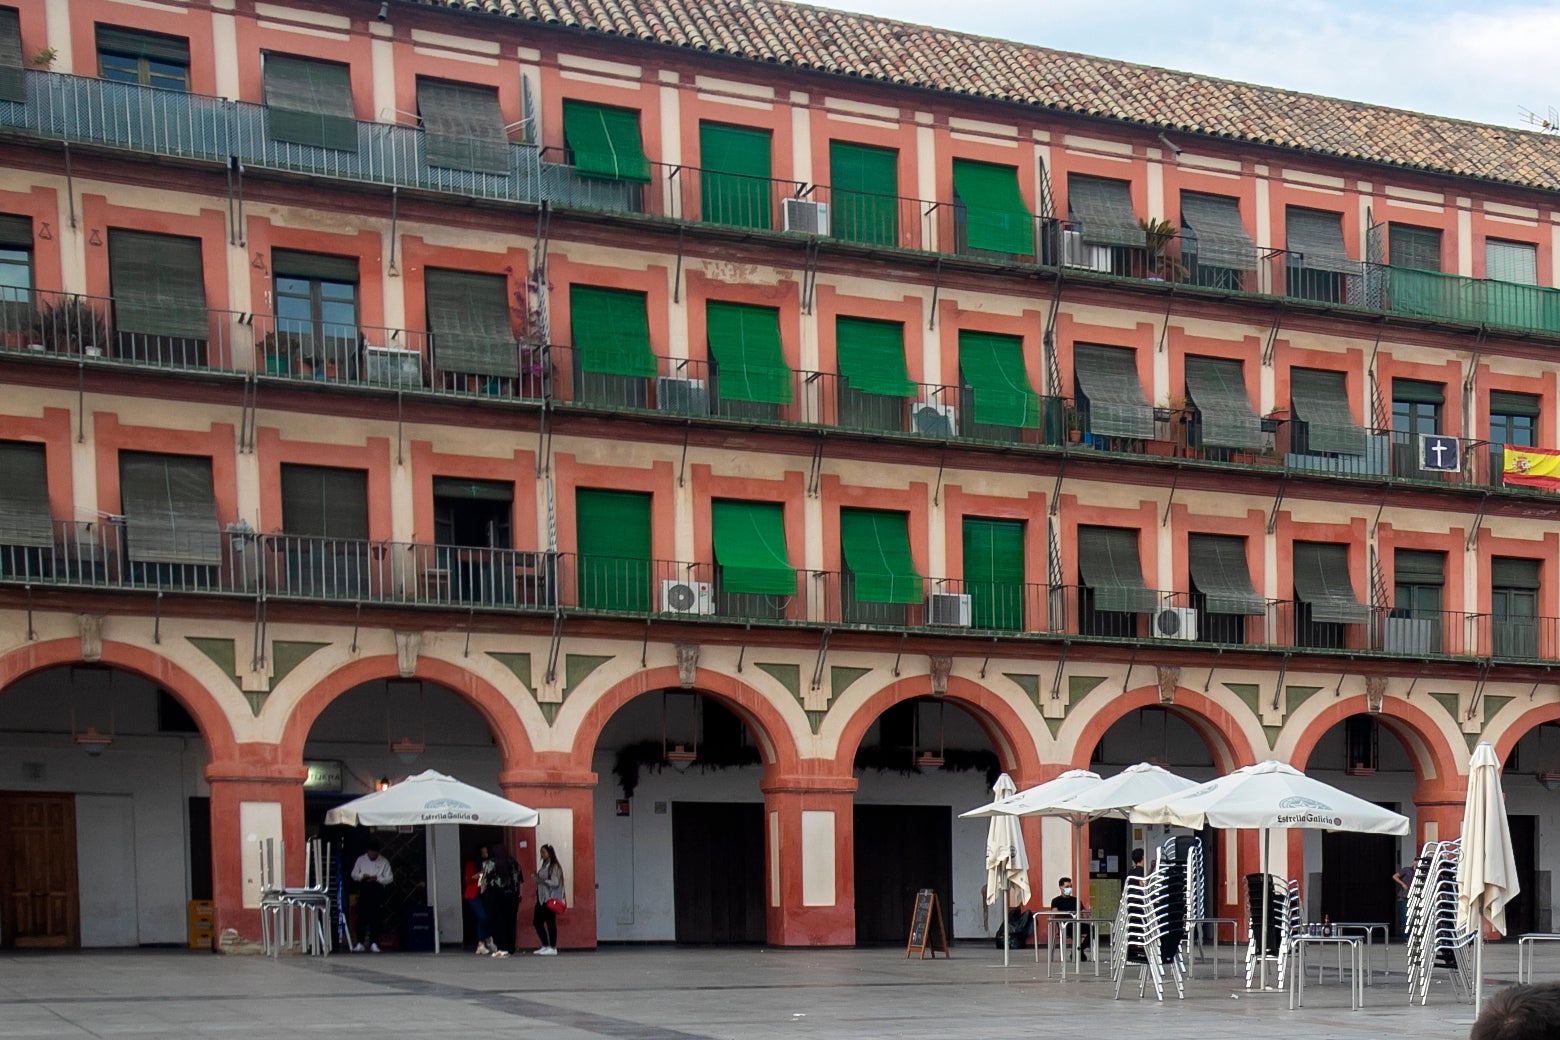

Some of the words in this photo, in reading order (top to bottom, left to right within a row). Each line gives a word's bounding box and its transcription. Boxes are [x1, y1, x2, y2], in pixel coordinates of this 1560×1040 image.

[421, 813, 447, 821] Estrella
[448, 812, 470, 820] Galicia
[1277, 814, 1306, 823] Estrella
[1306, 813, 1333, 825] Galicia
